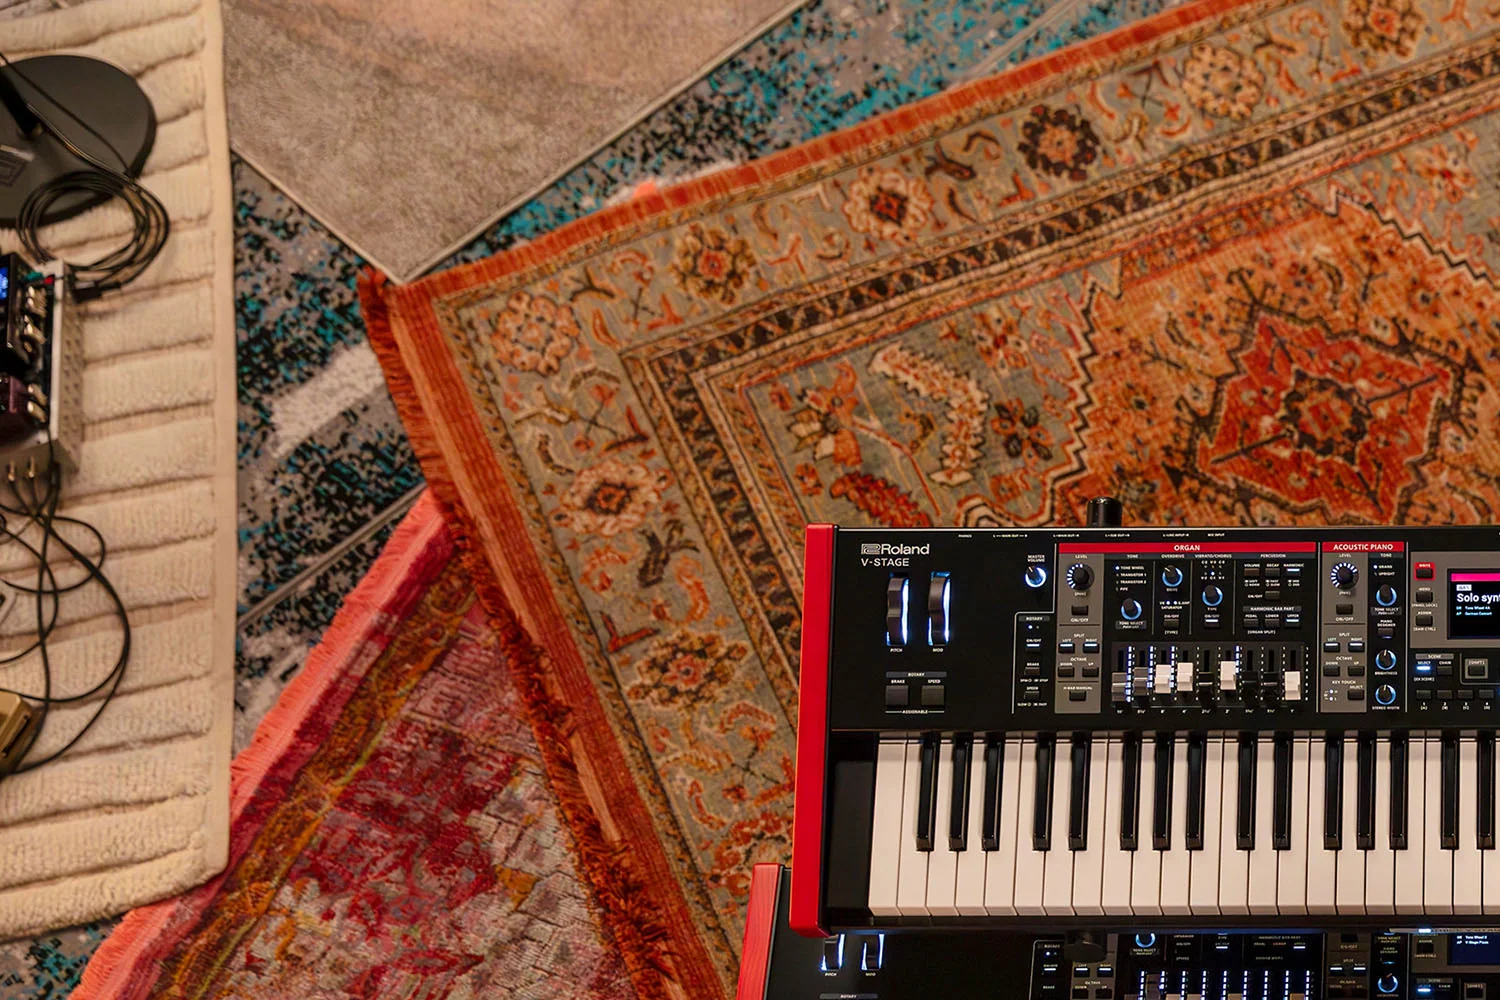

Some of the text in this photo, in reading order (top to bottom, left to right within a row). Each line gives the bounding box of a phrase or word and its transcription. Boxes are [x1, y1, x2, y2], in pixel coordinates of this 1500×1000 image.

[881, 544, 930, 554] Roland
[861, 558, 910, 566] V-STAGE
[1457, 593, 1479, 602] Solo
